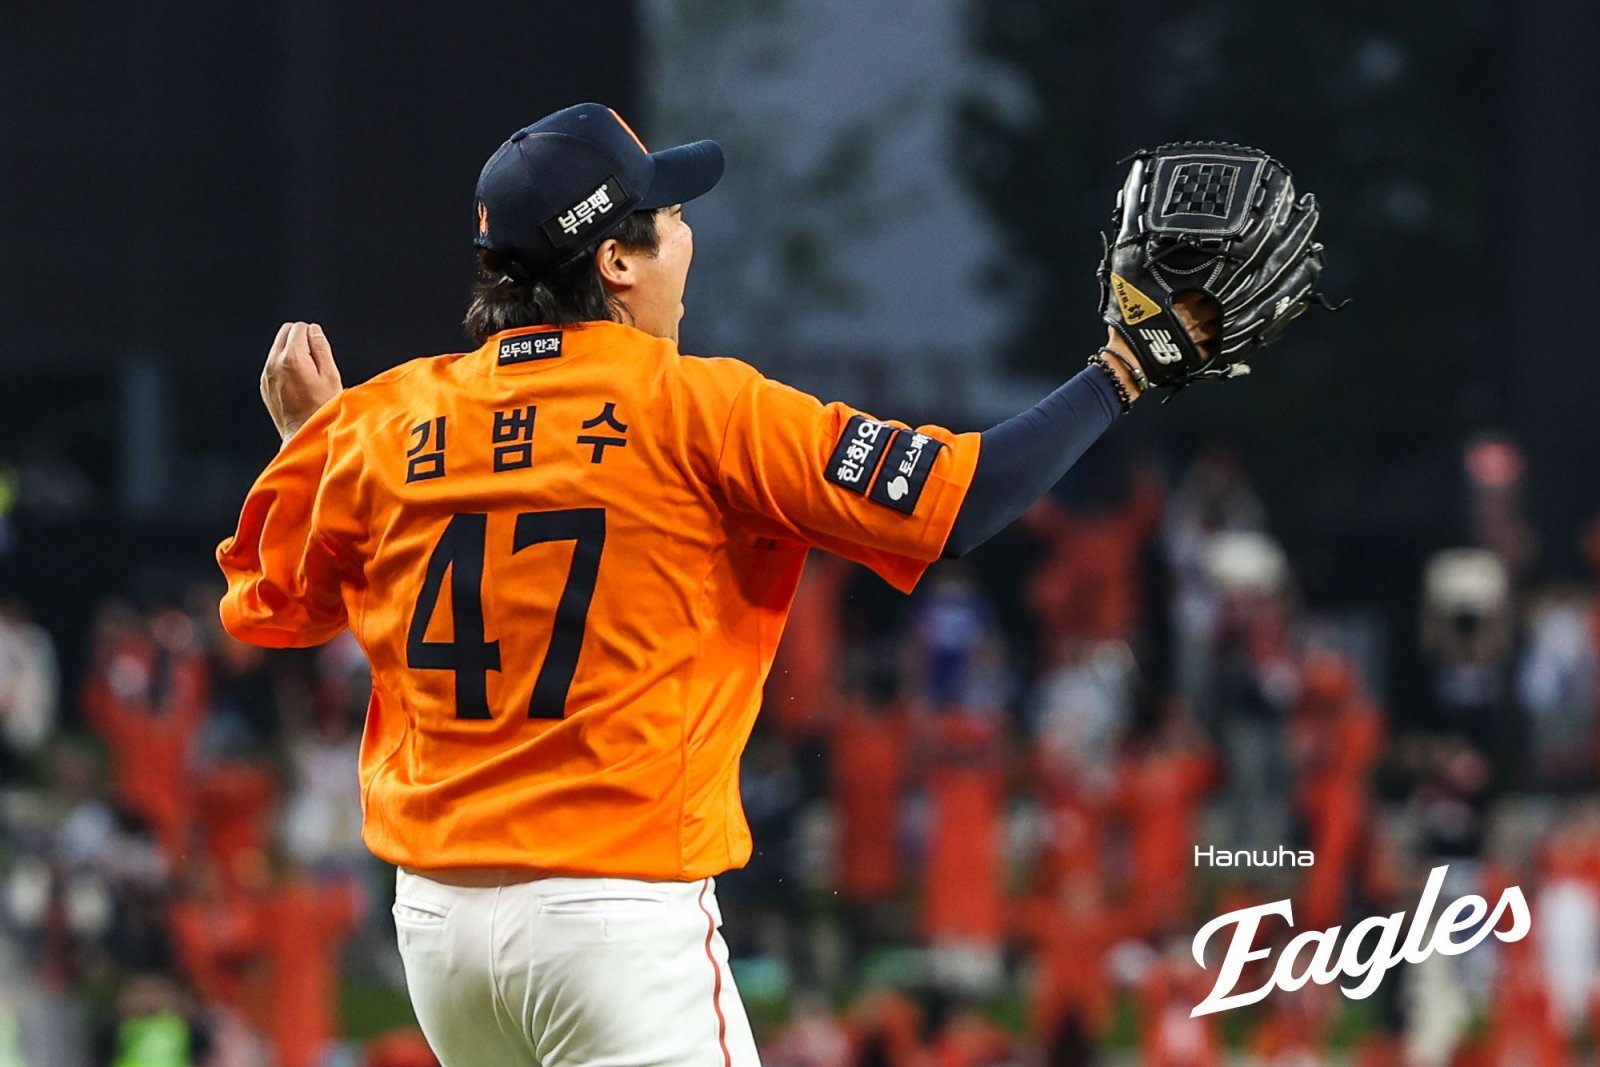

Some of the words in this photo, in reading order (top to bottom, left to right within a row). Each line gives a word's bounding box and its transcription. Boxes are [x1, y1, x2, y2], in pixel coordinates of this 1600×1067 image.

[500, 341, 532, 358] 모두의
[534, 337, 560, 353] 안과
[837, 419, 889, 483] 한화오
[406, 508, 606, 720] 47
